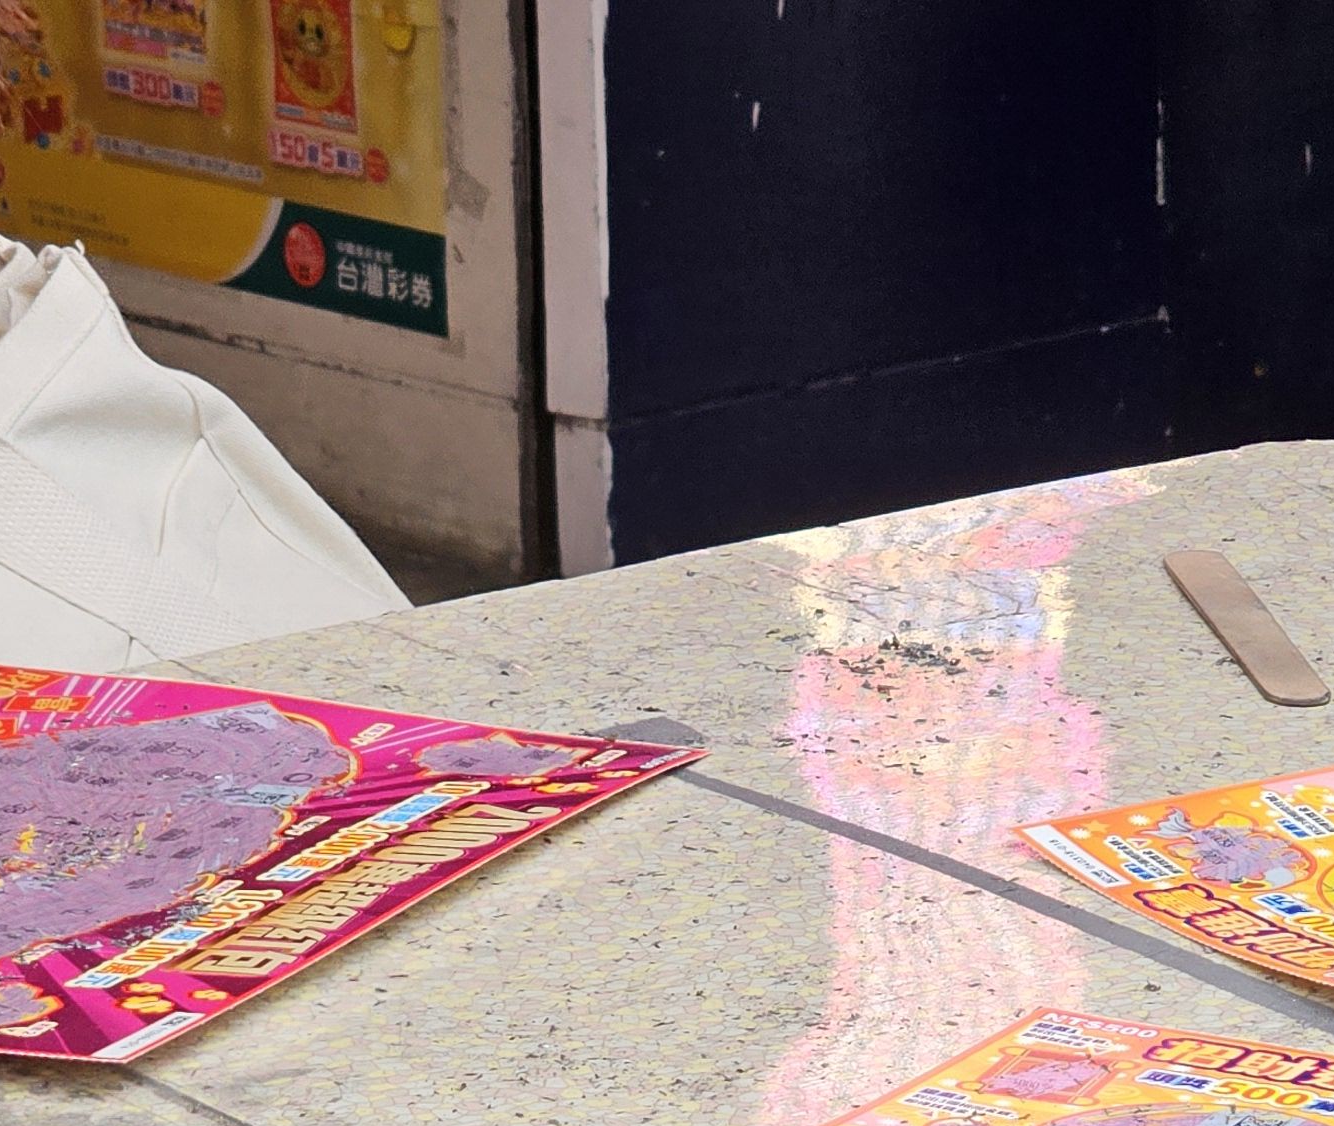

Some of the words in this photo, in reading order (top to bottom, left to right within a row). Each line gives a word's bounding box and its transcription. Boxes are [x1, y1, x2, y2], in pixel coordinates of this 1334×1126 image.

[337, 257, 432, 308] 台灣彩券
[170, 803, 561, 976] 2000萬超級紅包
[1042, 1012, 1159, 1038] NT$500
